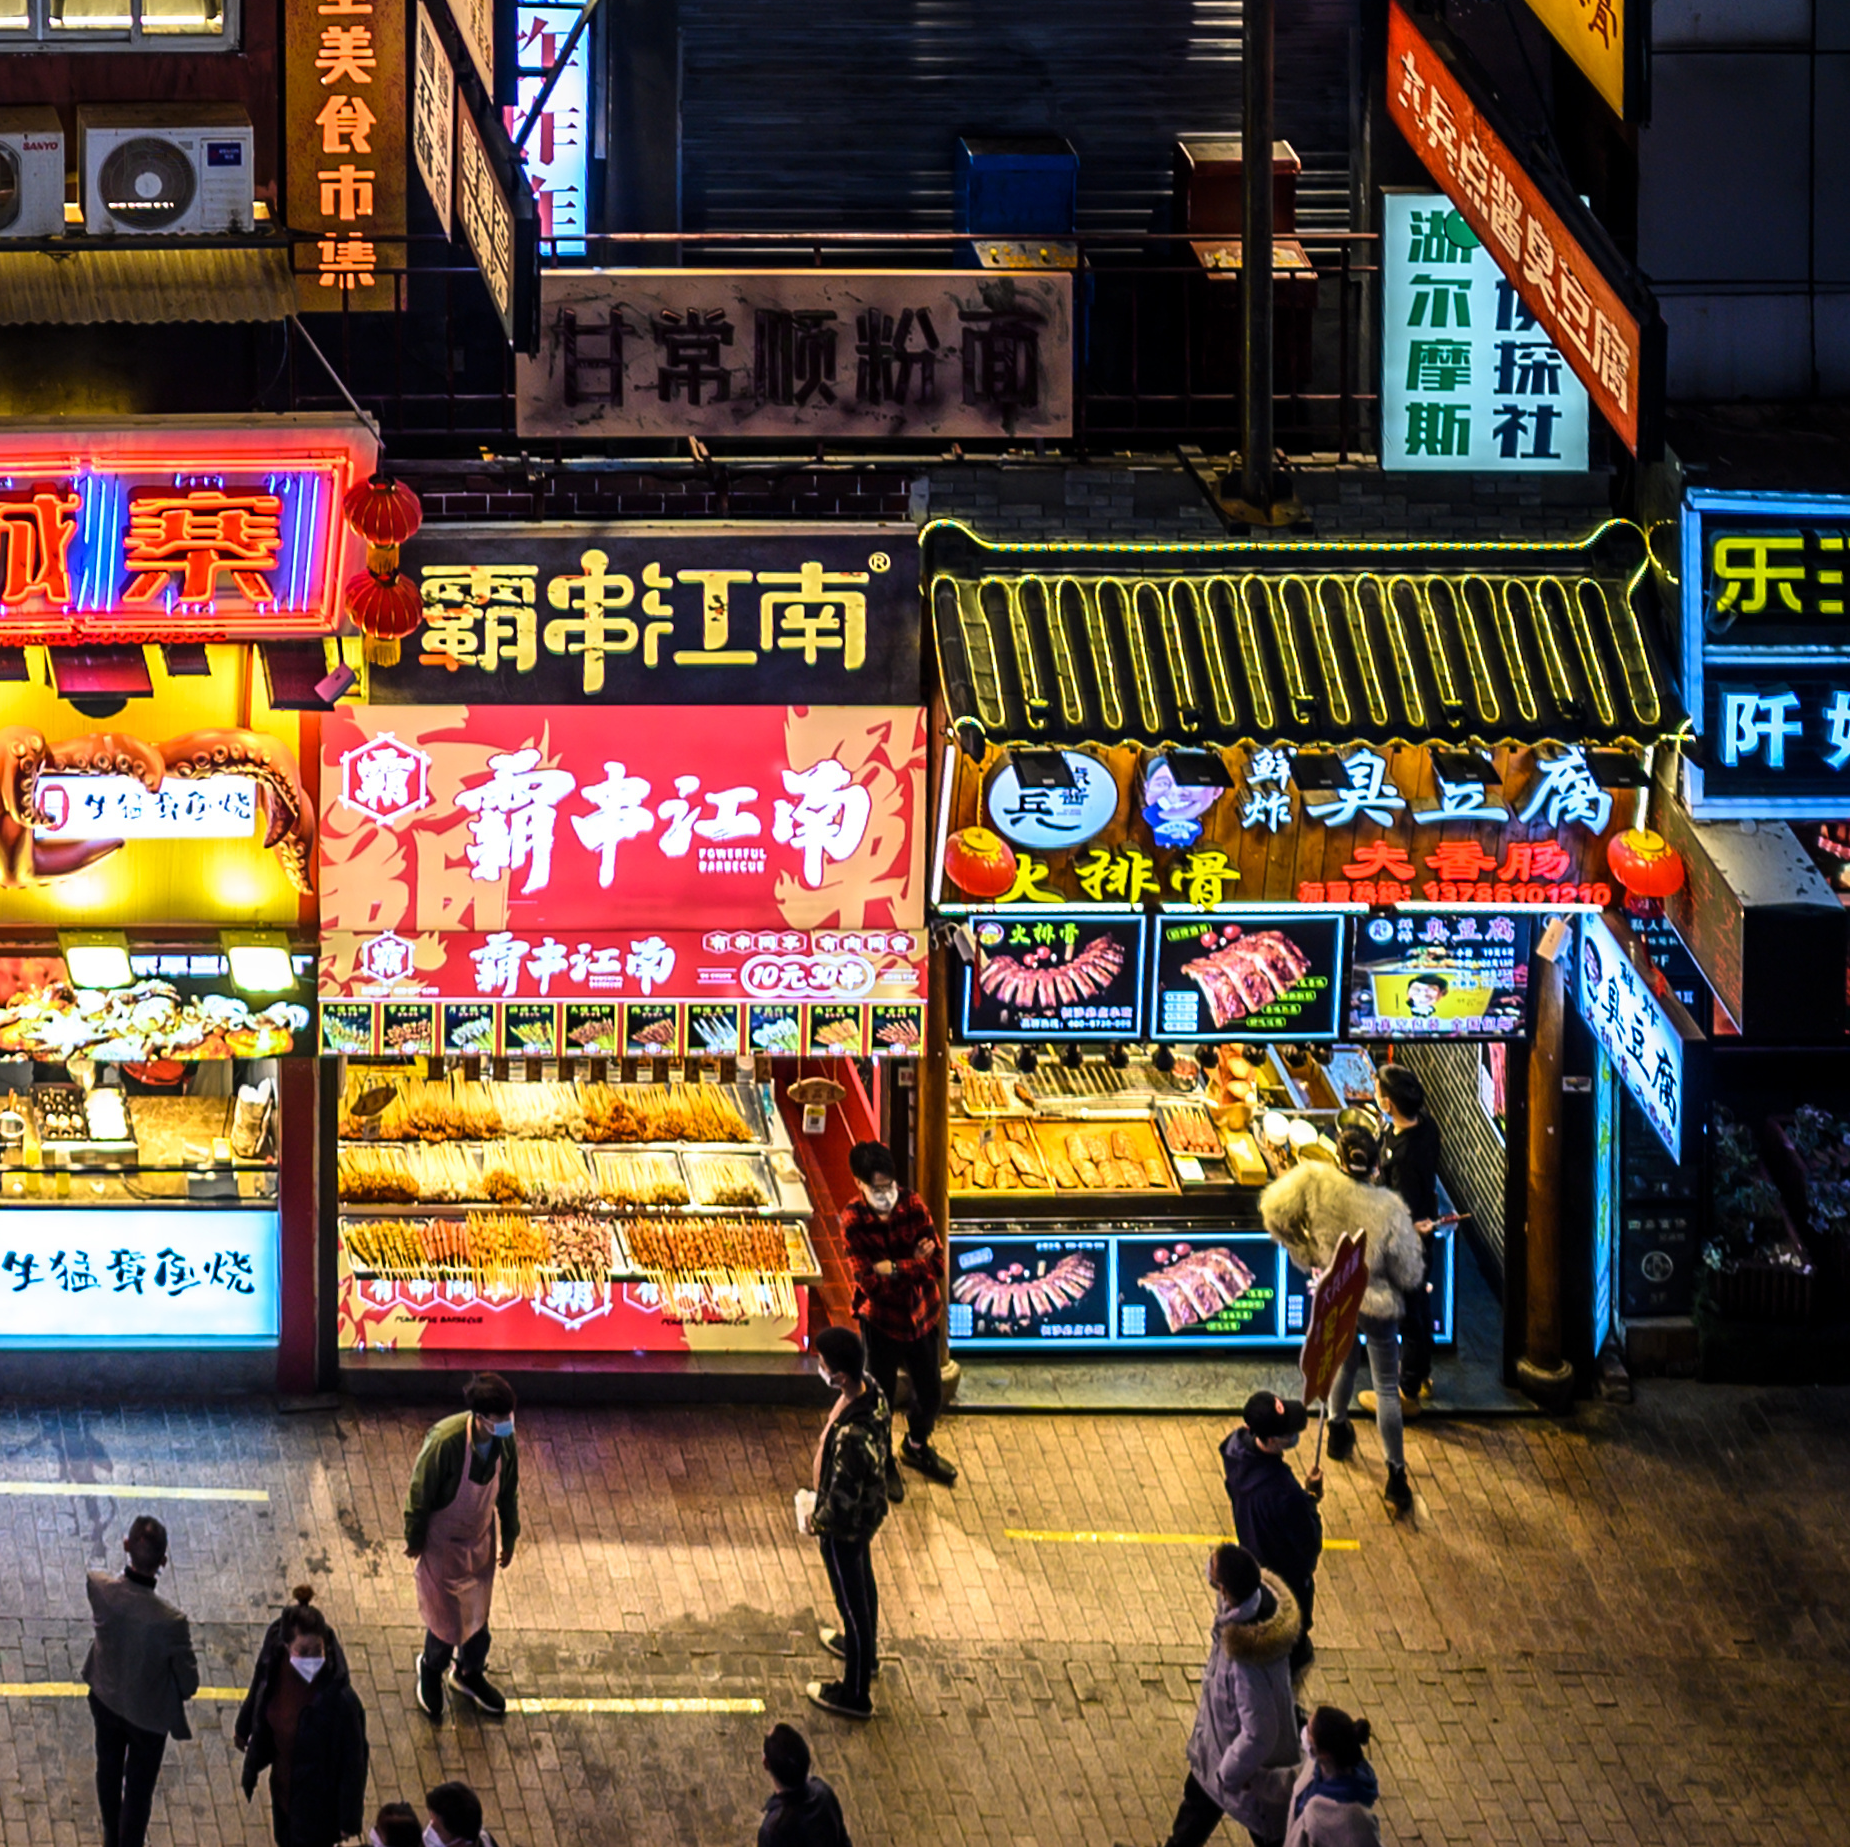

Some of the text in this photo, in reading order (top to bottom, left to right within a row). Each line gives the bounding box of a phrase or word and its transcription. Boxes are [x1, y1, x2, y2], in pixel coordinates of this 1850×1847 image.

[23, 141, 59, 151] SANYO
[419, 549, 871, 694] 霸串江南
[455, 747, 874, 894] 霸串江南
[1242, 749, 1296, 833] 鲜炸
[997, 848, 1242, 912] 火排骨
[1342, 840, 1571, 880] 大香肠
[469, 933, 676, 996] 霸串江南
[1009, 923, 1080, 946] 火排骨
